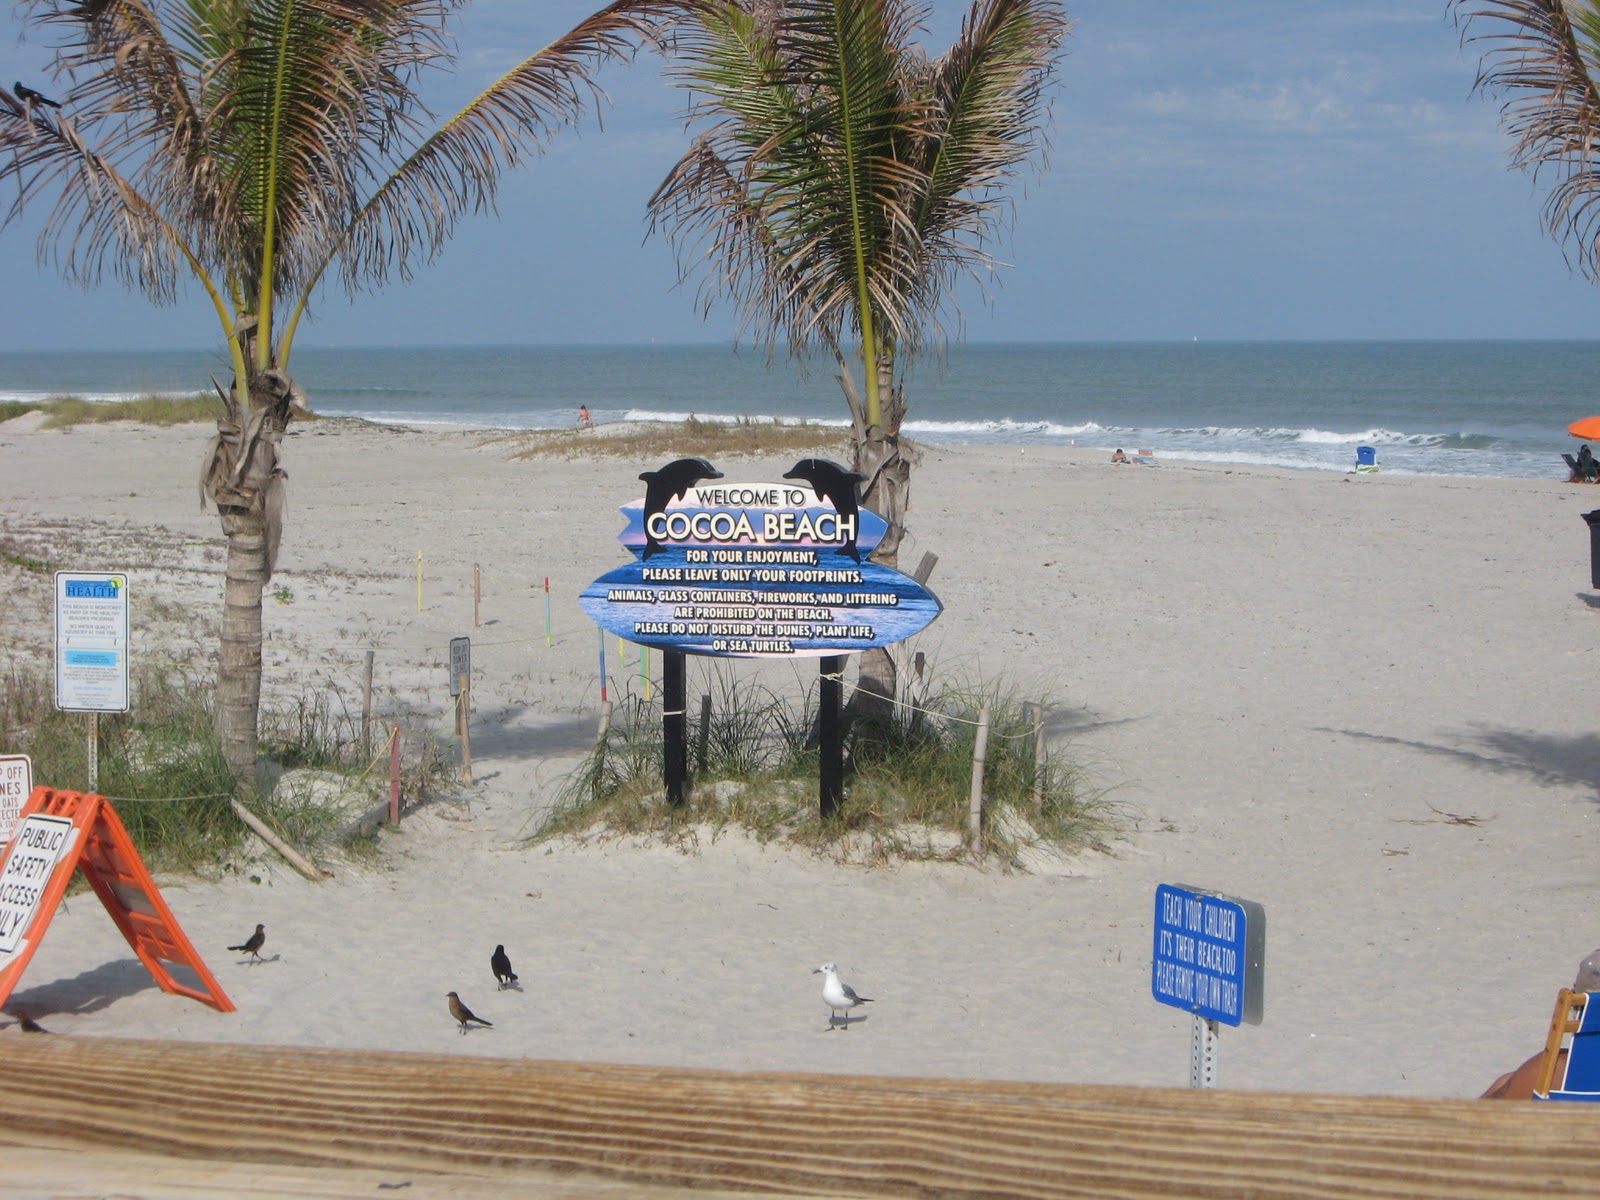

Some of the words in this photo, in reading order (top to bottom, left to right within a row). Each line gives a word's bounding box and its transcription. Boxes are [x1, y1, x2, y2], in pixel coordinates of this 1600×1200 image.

[696, 489, 778, 506] WELCOME
[783, 489, 806, 506] TO
[646, 510, 757, 542] COCOA
[763, 510, 856, 542] BEACH
[686, 550, 708, 562] FOR
[712, 550, 743, 562] YOUR
[746, 551, 818, 566] ENJOYMENT,
[642, 568, 682, 580] PLEASE
[685, 569, 718, 581] LEAVE
[722, 570, 754, 582] ONLY
[754, 570, 786, 582] YOUR
[790, 570, 863, 583] FOOTPRINTS.
[68, 586, 116, 598] HEALTH
[608, 590, 656, 603] ANIMALS,
[658, 590, 688, 602] GLASS
[690, 590, 756, 604] CONTAINERS,
[758, 592, 818, 605] FIREWORKS,
[820, 594, 843, 604] AND
[846, 594, 897, 605] LITTERING
[674, 606, 694, 618] ARE
[696, 607, 756, 620] PROHIBITED
[758, 608, 774, 620] ON
[776, 608, 796, 620] THE
[797, 609, 832, 620] BEACH.
[634, 622, 669, 634] PLEASE
[672, 622, 686, 634] DO
[688, 623, 709, 634] NOT
[712, 624, 754, 635] DISTURB
[756, 625, 774, 636] THE
[777, 626, 812, 638] DUNES,
[816, 626, 848, 637] PLANT
[850, 626, 874, 638] LIFE,
[712, 640, 728, 650] OR
[730, 640, 748, 651] SEA
[751, 641, 794, 652] TURTLES.
[7, 766, 23, 780] OFF
[0, 782, 20, 796] NES
[2, 797, 18, 808] OATS
[20, 827, 62, 851] PUBLIC
[7, 854, 50, 880] SAFETY
[1163, 892, 1182, 928] TEACH
[1185, 898, 1202, 933] YOUR
[1204, 904, 1236, 942] CHILDREN
[1176, 934, 1195, 964] THEIR
[1156, 960, 1175, 996] PLEASE
